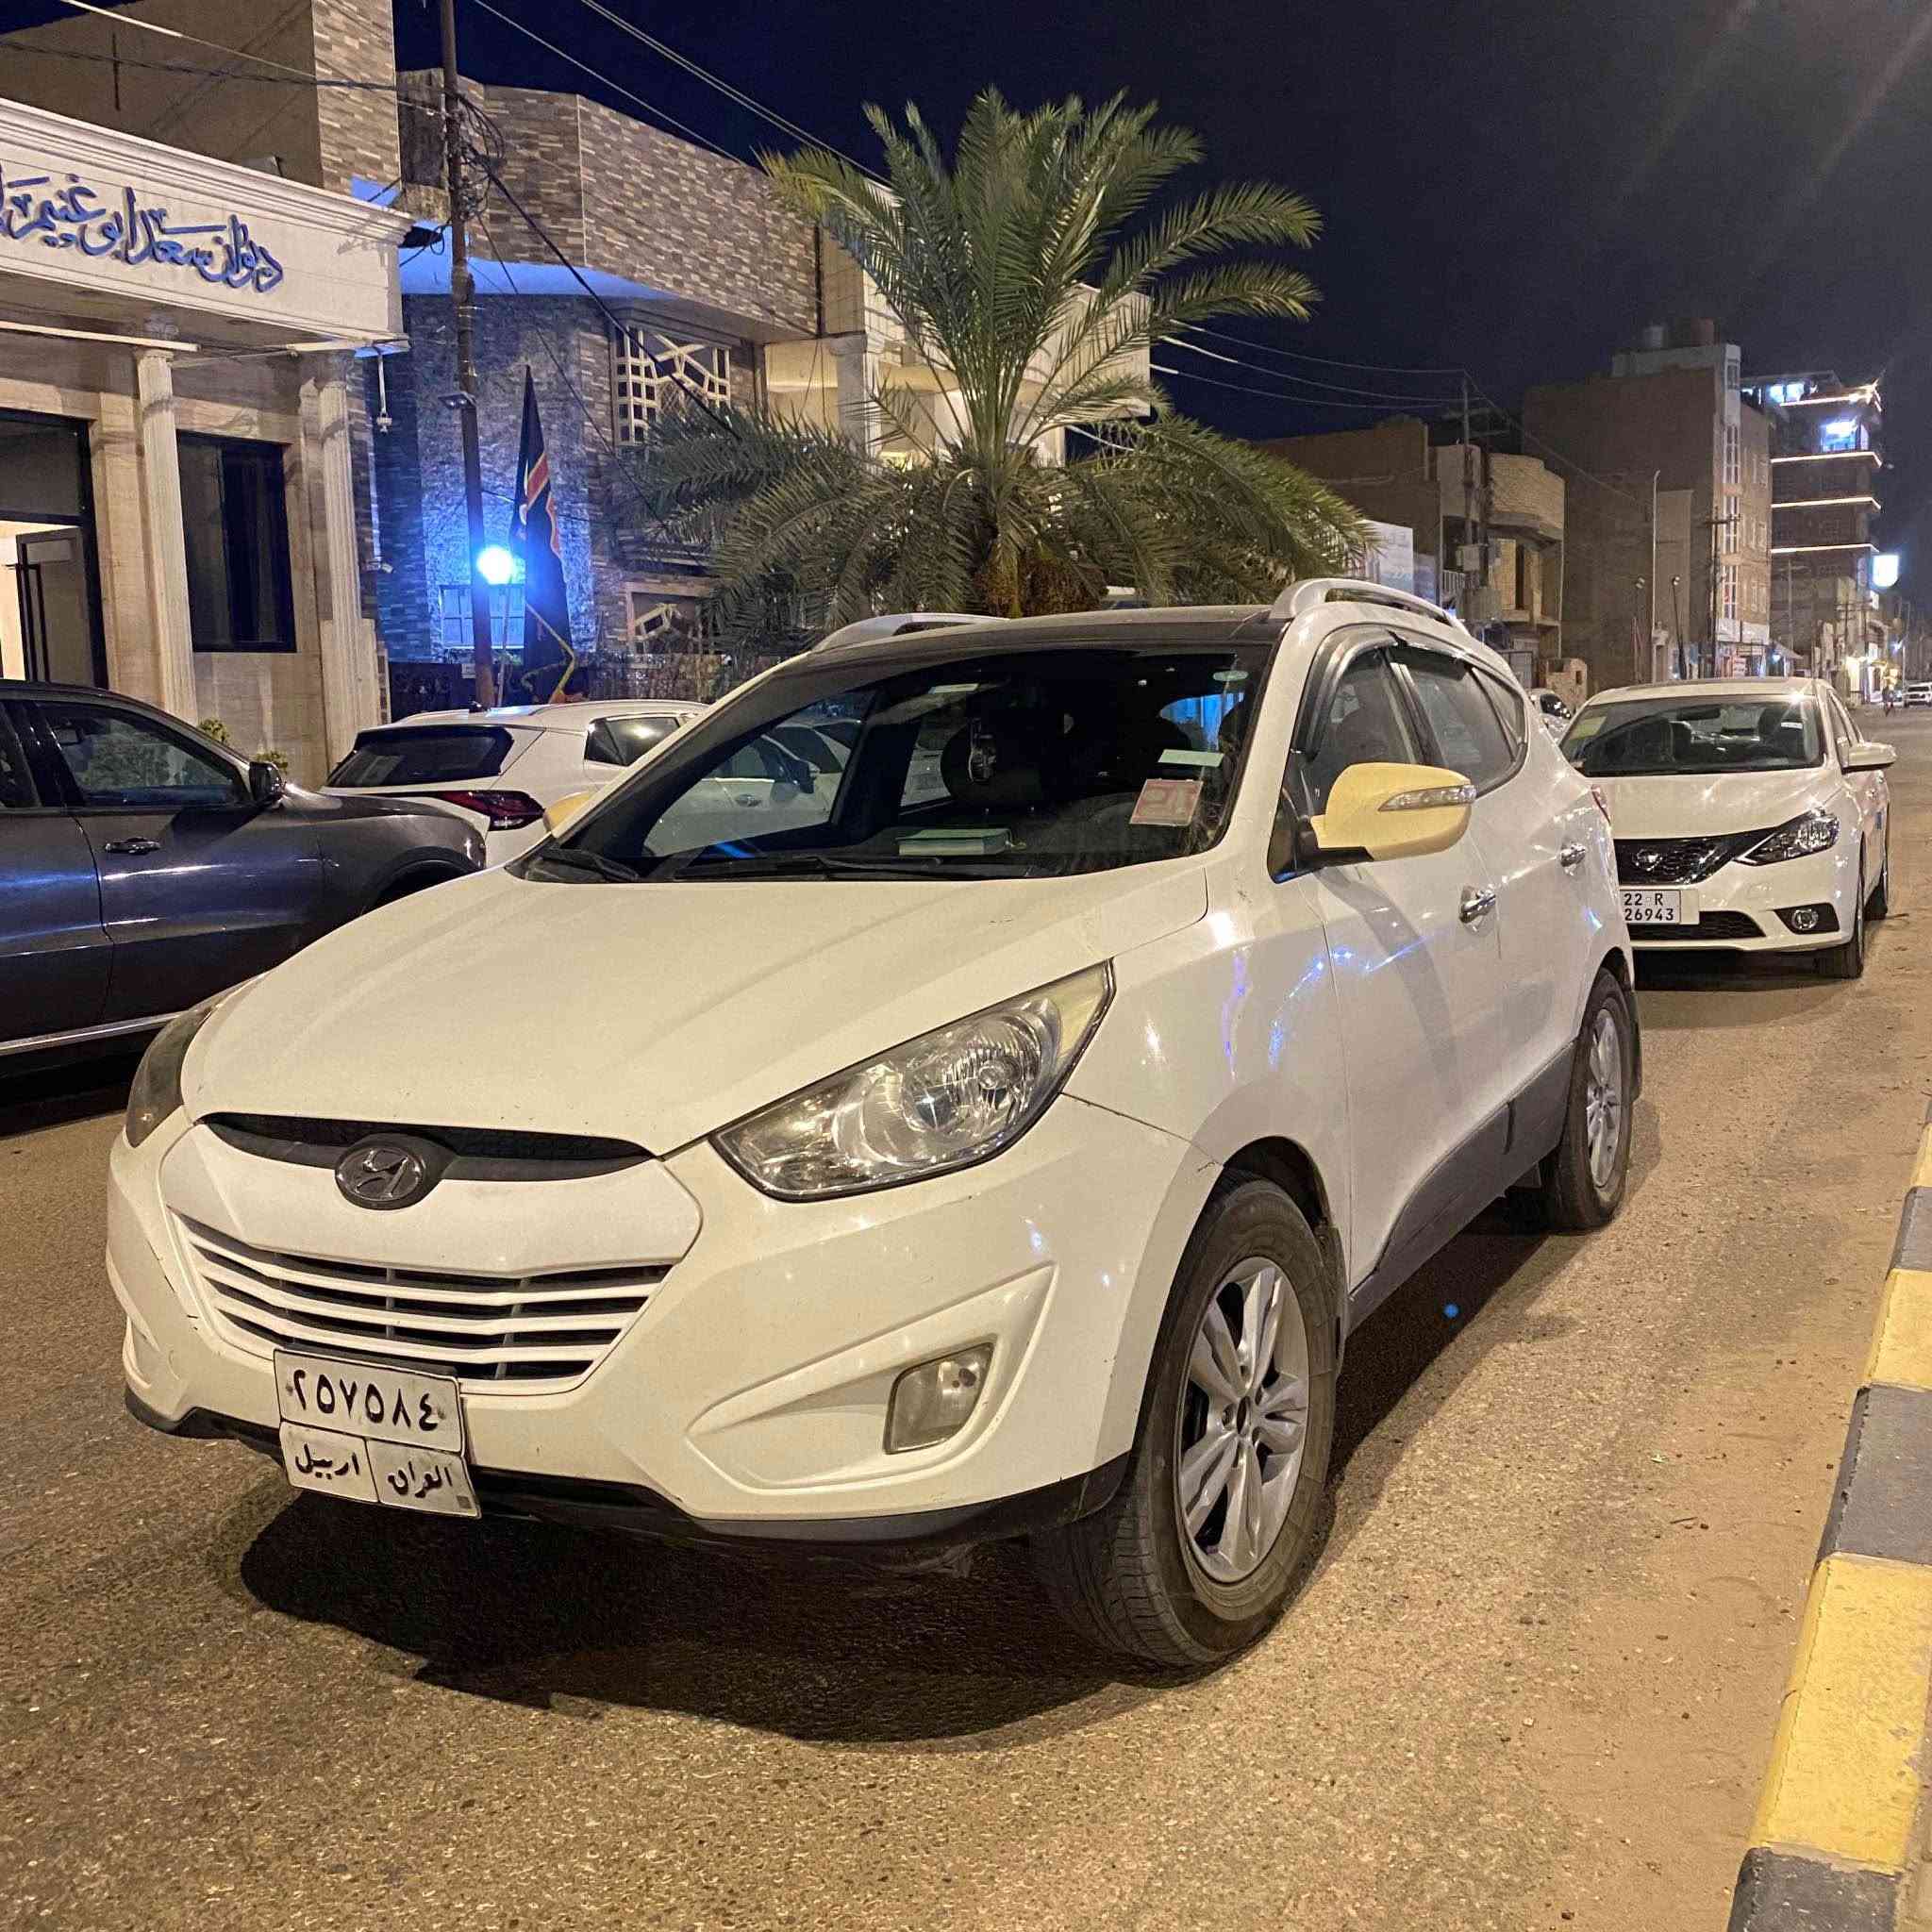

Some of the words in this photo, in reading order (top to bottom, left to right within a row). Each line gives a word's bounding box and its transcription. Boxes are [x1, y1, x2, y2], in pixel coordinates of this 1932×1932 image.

[197, 214, 283, 293] ديوان
[1624, 892, 1642, 906] 22
[1655, 892, 1664, 906] R
[1624, 908, 1674, 921] 26943
[292, 1369, 439, 1432] ٢٥٧٥٨٤
